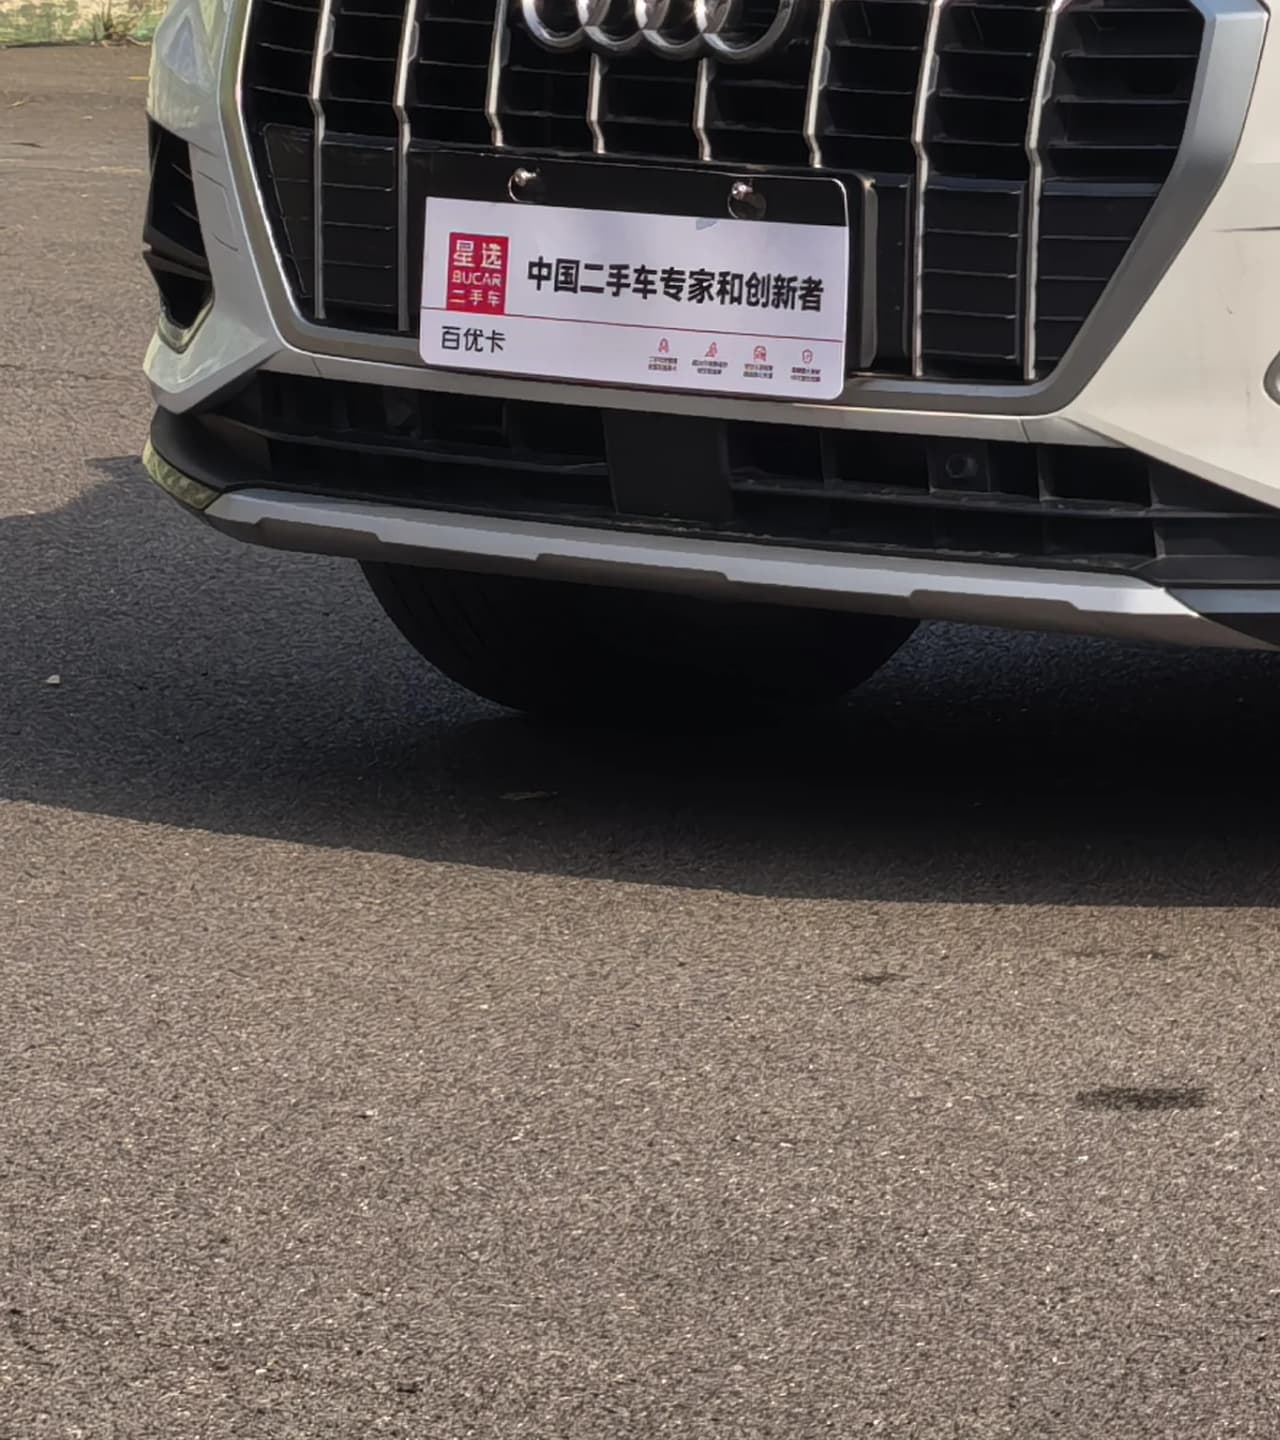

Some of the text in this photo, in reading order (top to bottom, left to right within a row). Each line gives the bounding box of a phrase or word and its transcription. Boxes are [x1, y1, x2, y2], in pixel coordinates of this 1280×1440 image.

[453, 240, 502, 269] 星选
[452, 270, 501, 287] BUCAR
[527, 256, 824, 312] 中国二手车专家和创新者
[449, 288, 501, 308] 二手车
[442, 326, 506, 353] 百优卡
